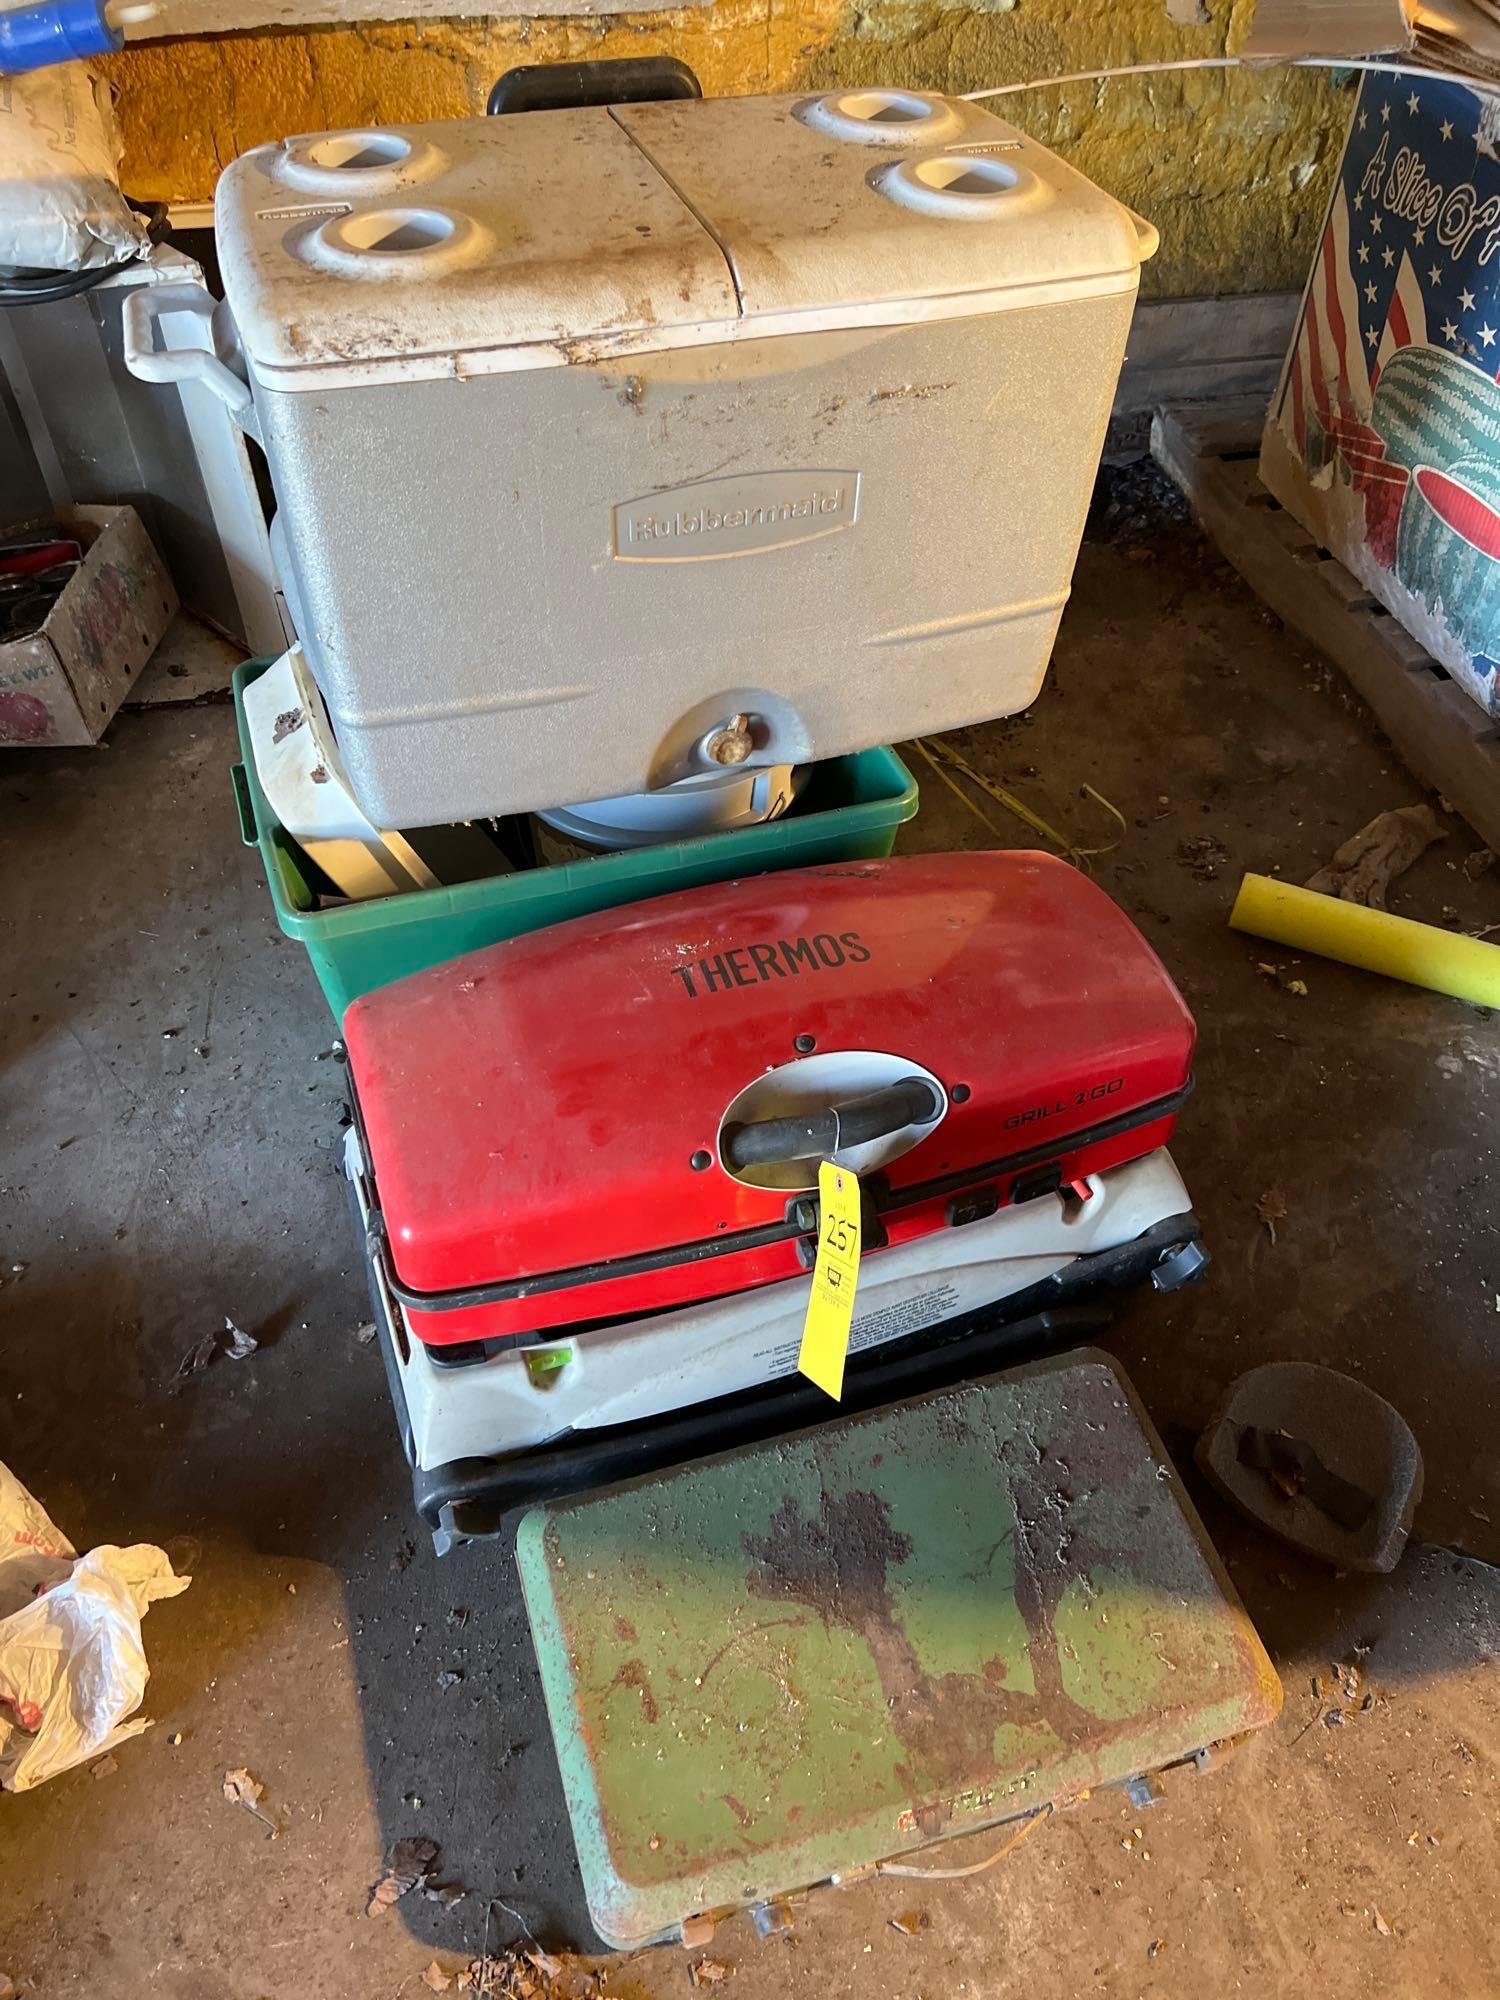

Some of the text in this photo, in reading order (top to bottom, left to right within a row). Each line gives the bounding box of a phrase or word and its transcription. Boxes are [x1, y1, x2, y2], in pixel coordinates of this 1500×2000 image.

[1361, 130, 1390, 199] A
[1383, 145, 1443, 227] Slice
[628, 488, 845, 542] Rubbermaid
[670, 932, 871, 998] THERMOS
[1003, 1101, 1068, 1130] GRILL
[1090, 1078, 1125, 1101] GO
